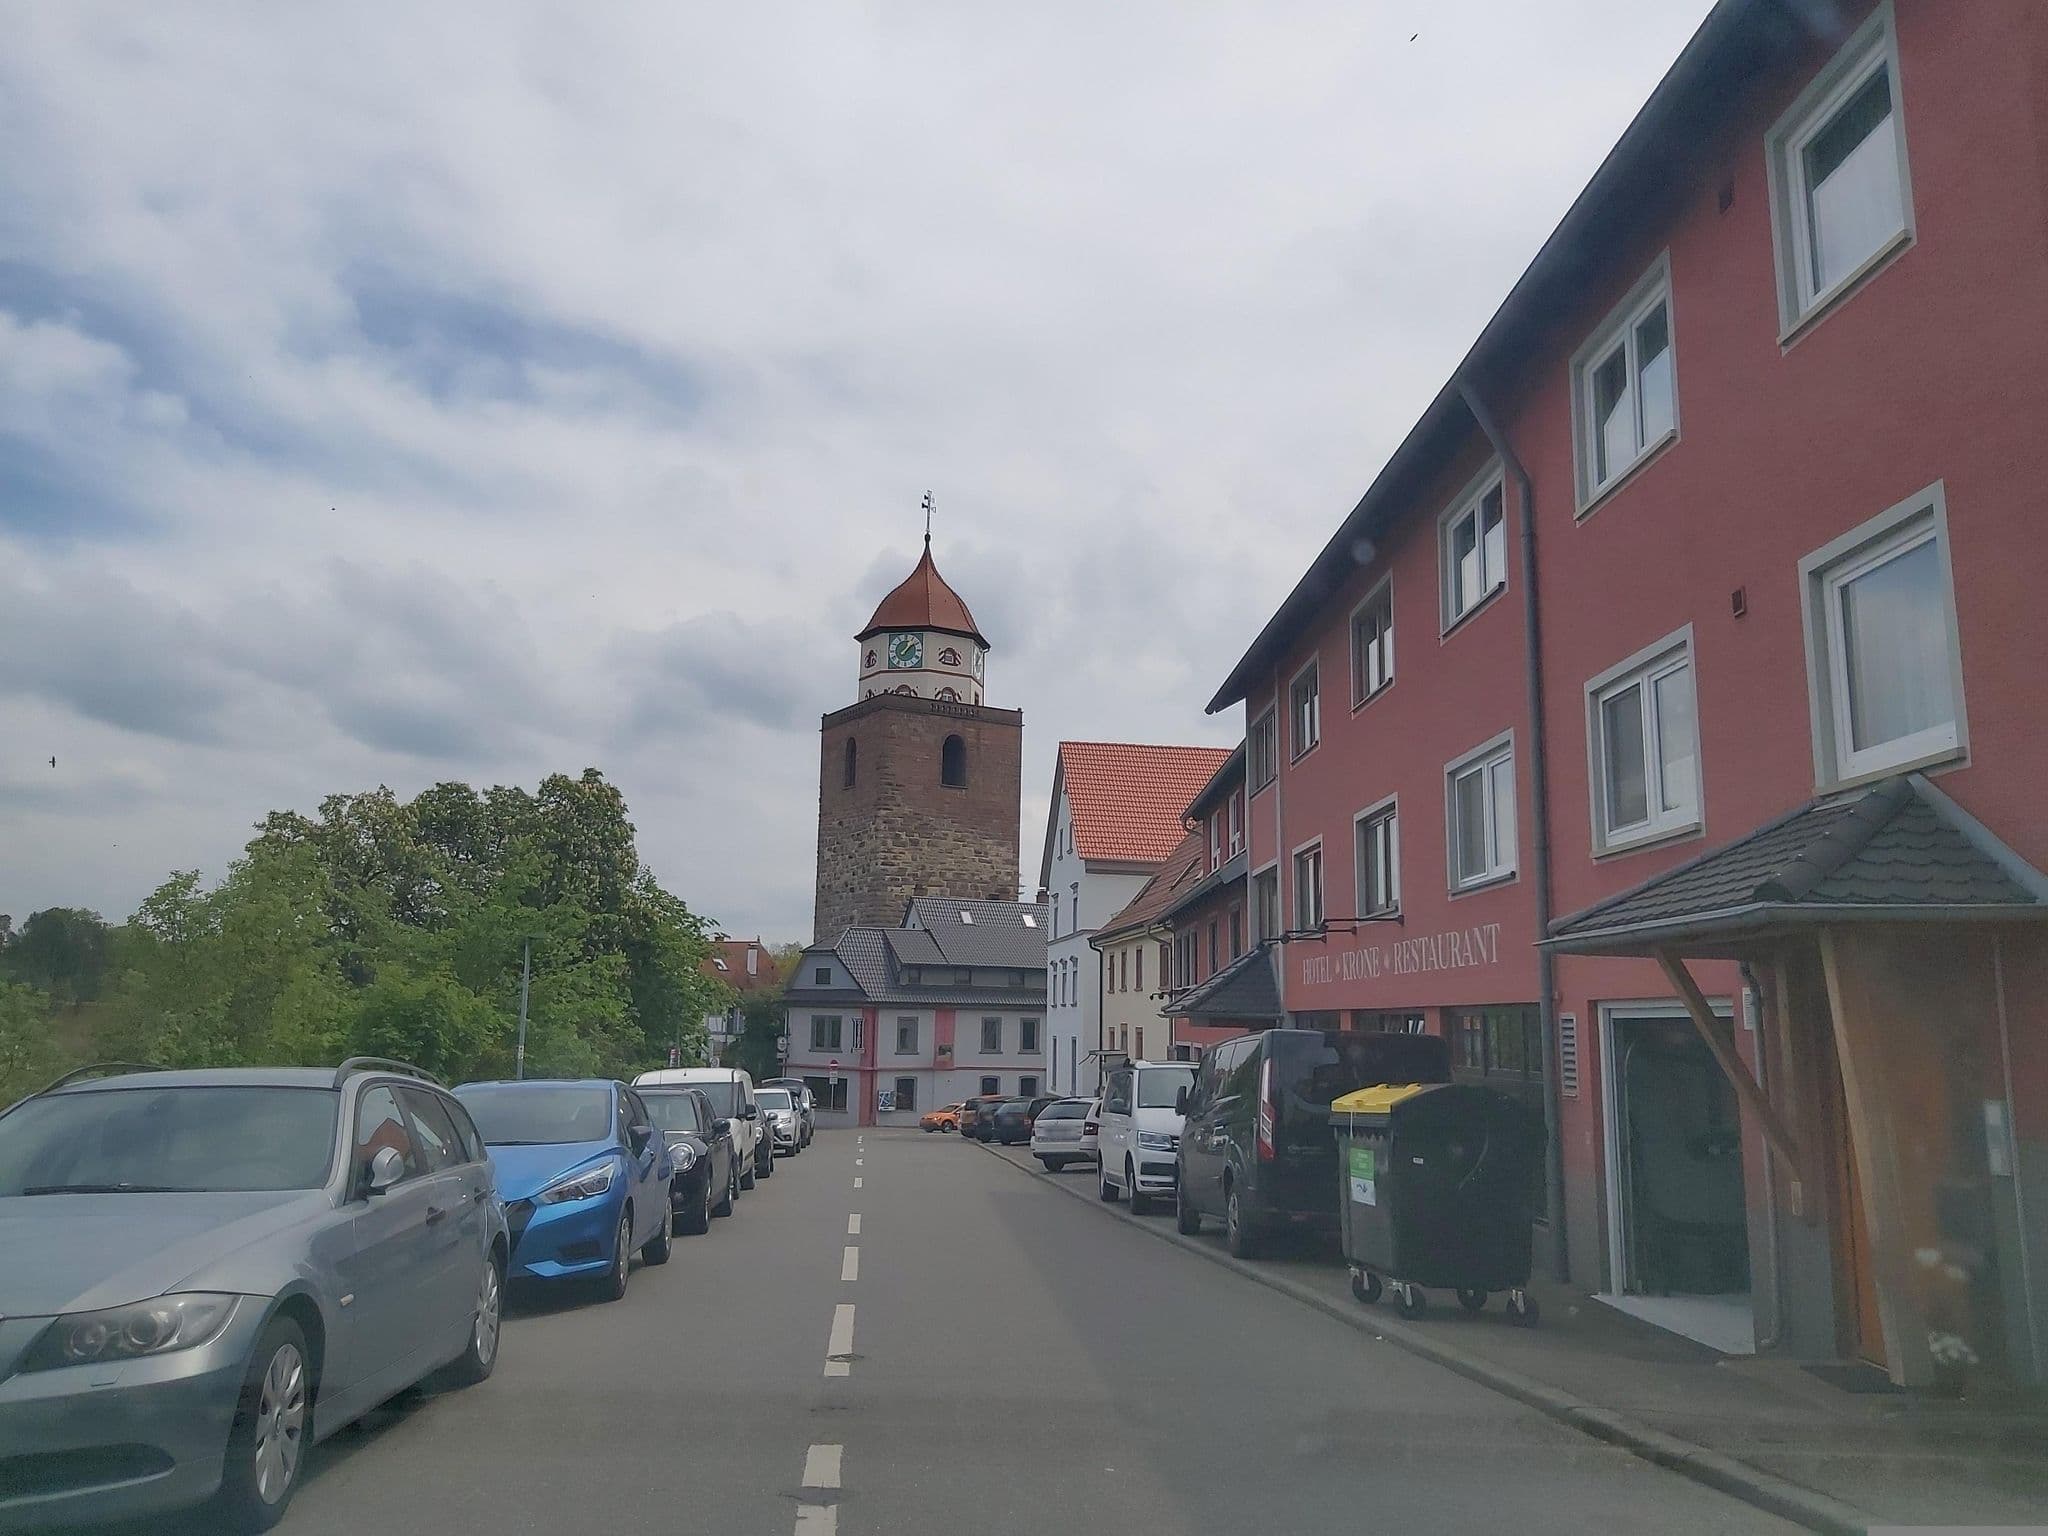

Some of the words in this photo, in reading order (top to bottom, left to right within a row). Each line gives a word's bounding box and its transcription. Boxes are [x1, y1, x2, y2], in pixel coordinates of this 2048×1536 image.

[1303, 955, 1333, 985] HOTEL
[1342, 946, 1380, 981] KRONE
[1393, 923, 1501, 975] RESTAURANT
